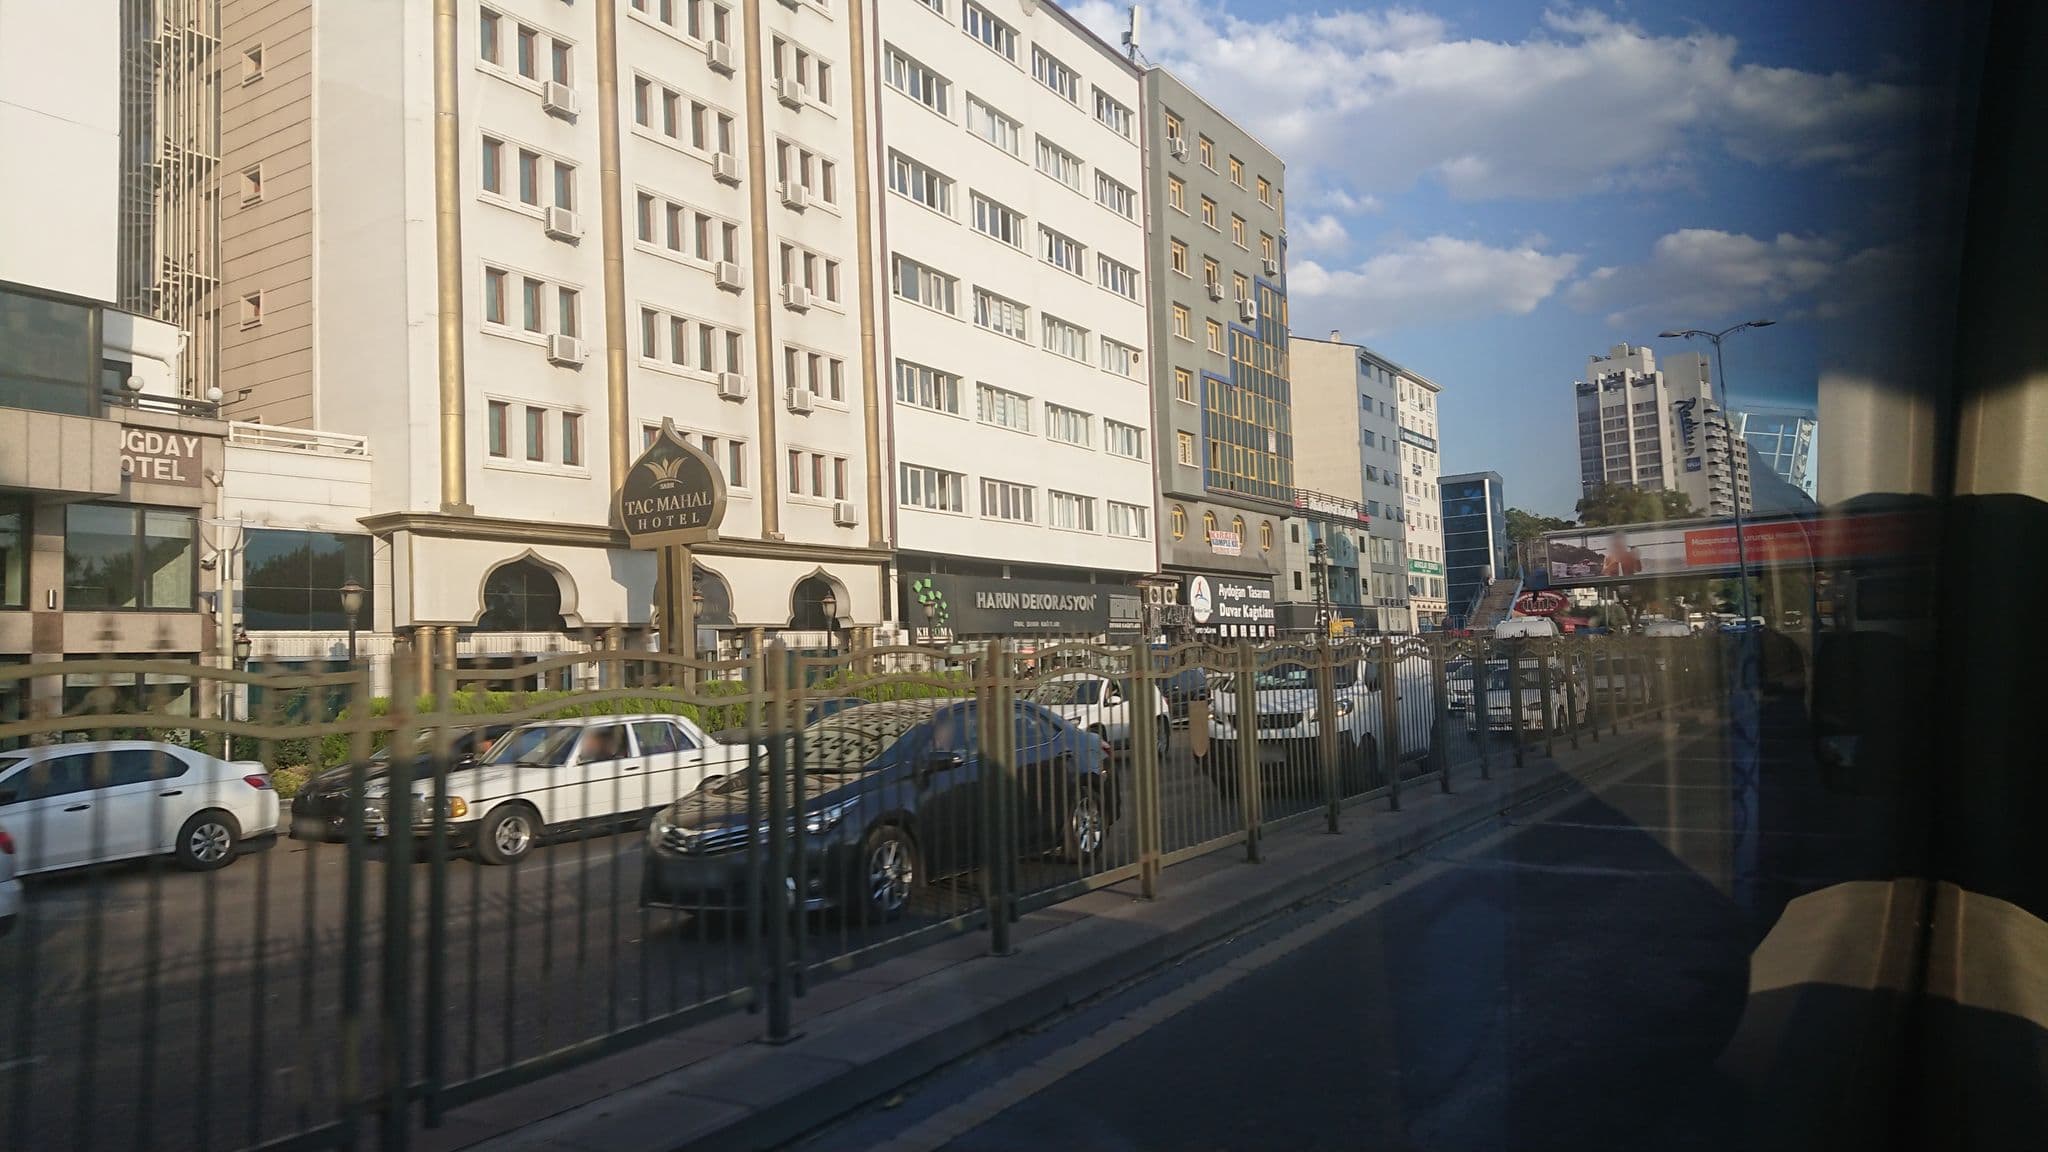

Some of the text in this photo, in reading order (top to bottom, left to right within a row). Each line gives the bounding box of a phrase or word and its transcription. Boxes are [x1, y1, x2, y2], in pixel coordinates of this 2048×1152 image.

[624, 491, 713, 516] TAC MAHAL
[638, 512, 700, 531] HOTEL
[976, 592, 1095, 611] HARUN DEKORASYON
[1218, 583, 1271, 601] Aydoğan Tasarım
[1219, 602, 1274, 621] Duvar Kağıtları
[916, 626, 953, 636] KHOMA
